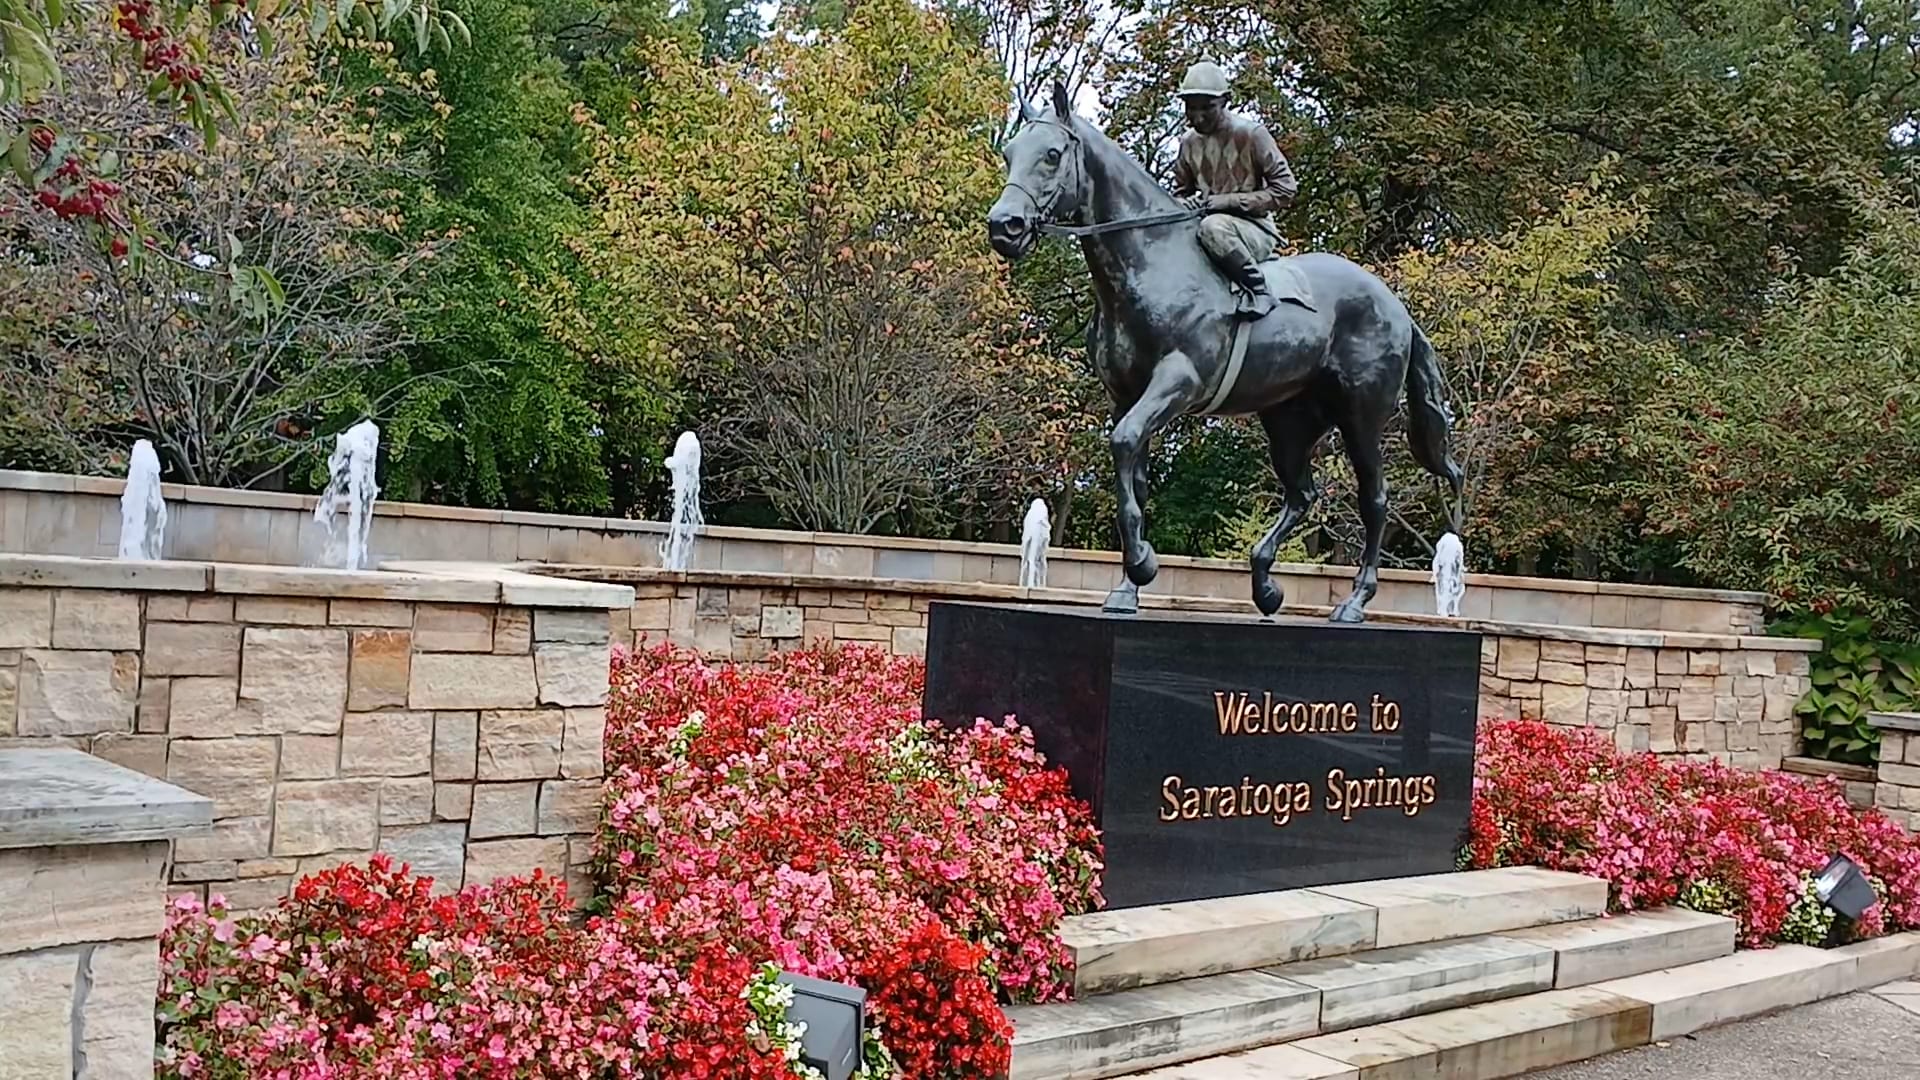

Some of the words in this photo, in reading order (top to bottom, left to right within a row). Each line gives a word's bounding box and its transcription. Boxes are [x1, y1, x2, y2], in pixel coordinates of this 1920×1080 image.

[1214, 691, 1358, 735] Welcome
[1371, 693, 1401, 732] to
[1159, 775, 1311, 825] Saratoga
[1325, 767, 1436, 820] Springs
